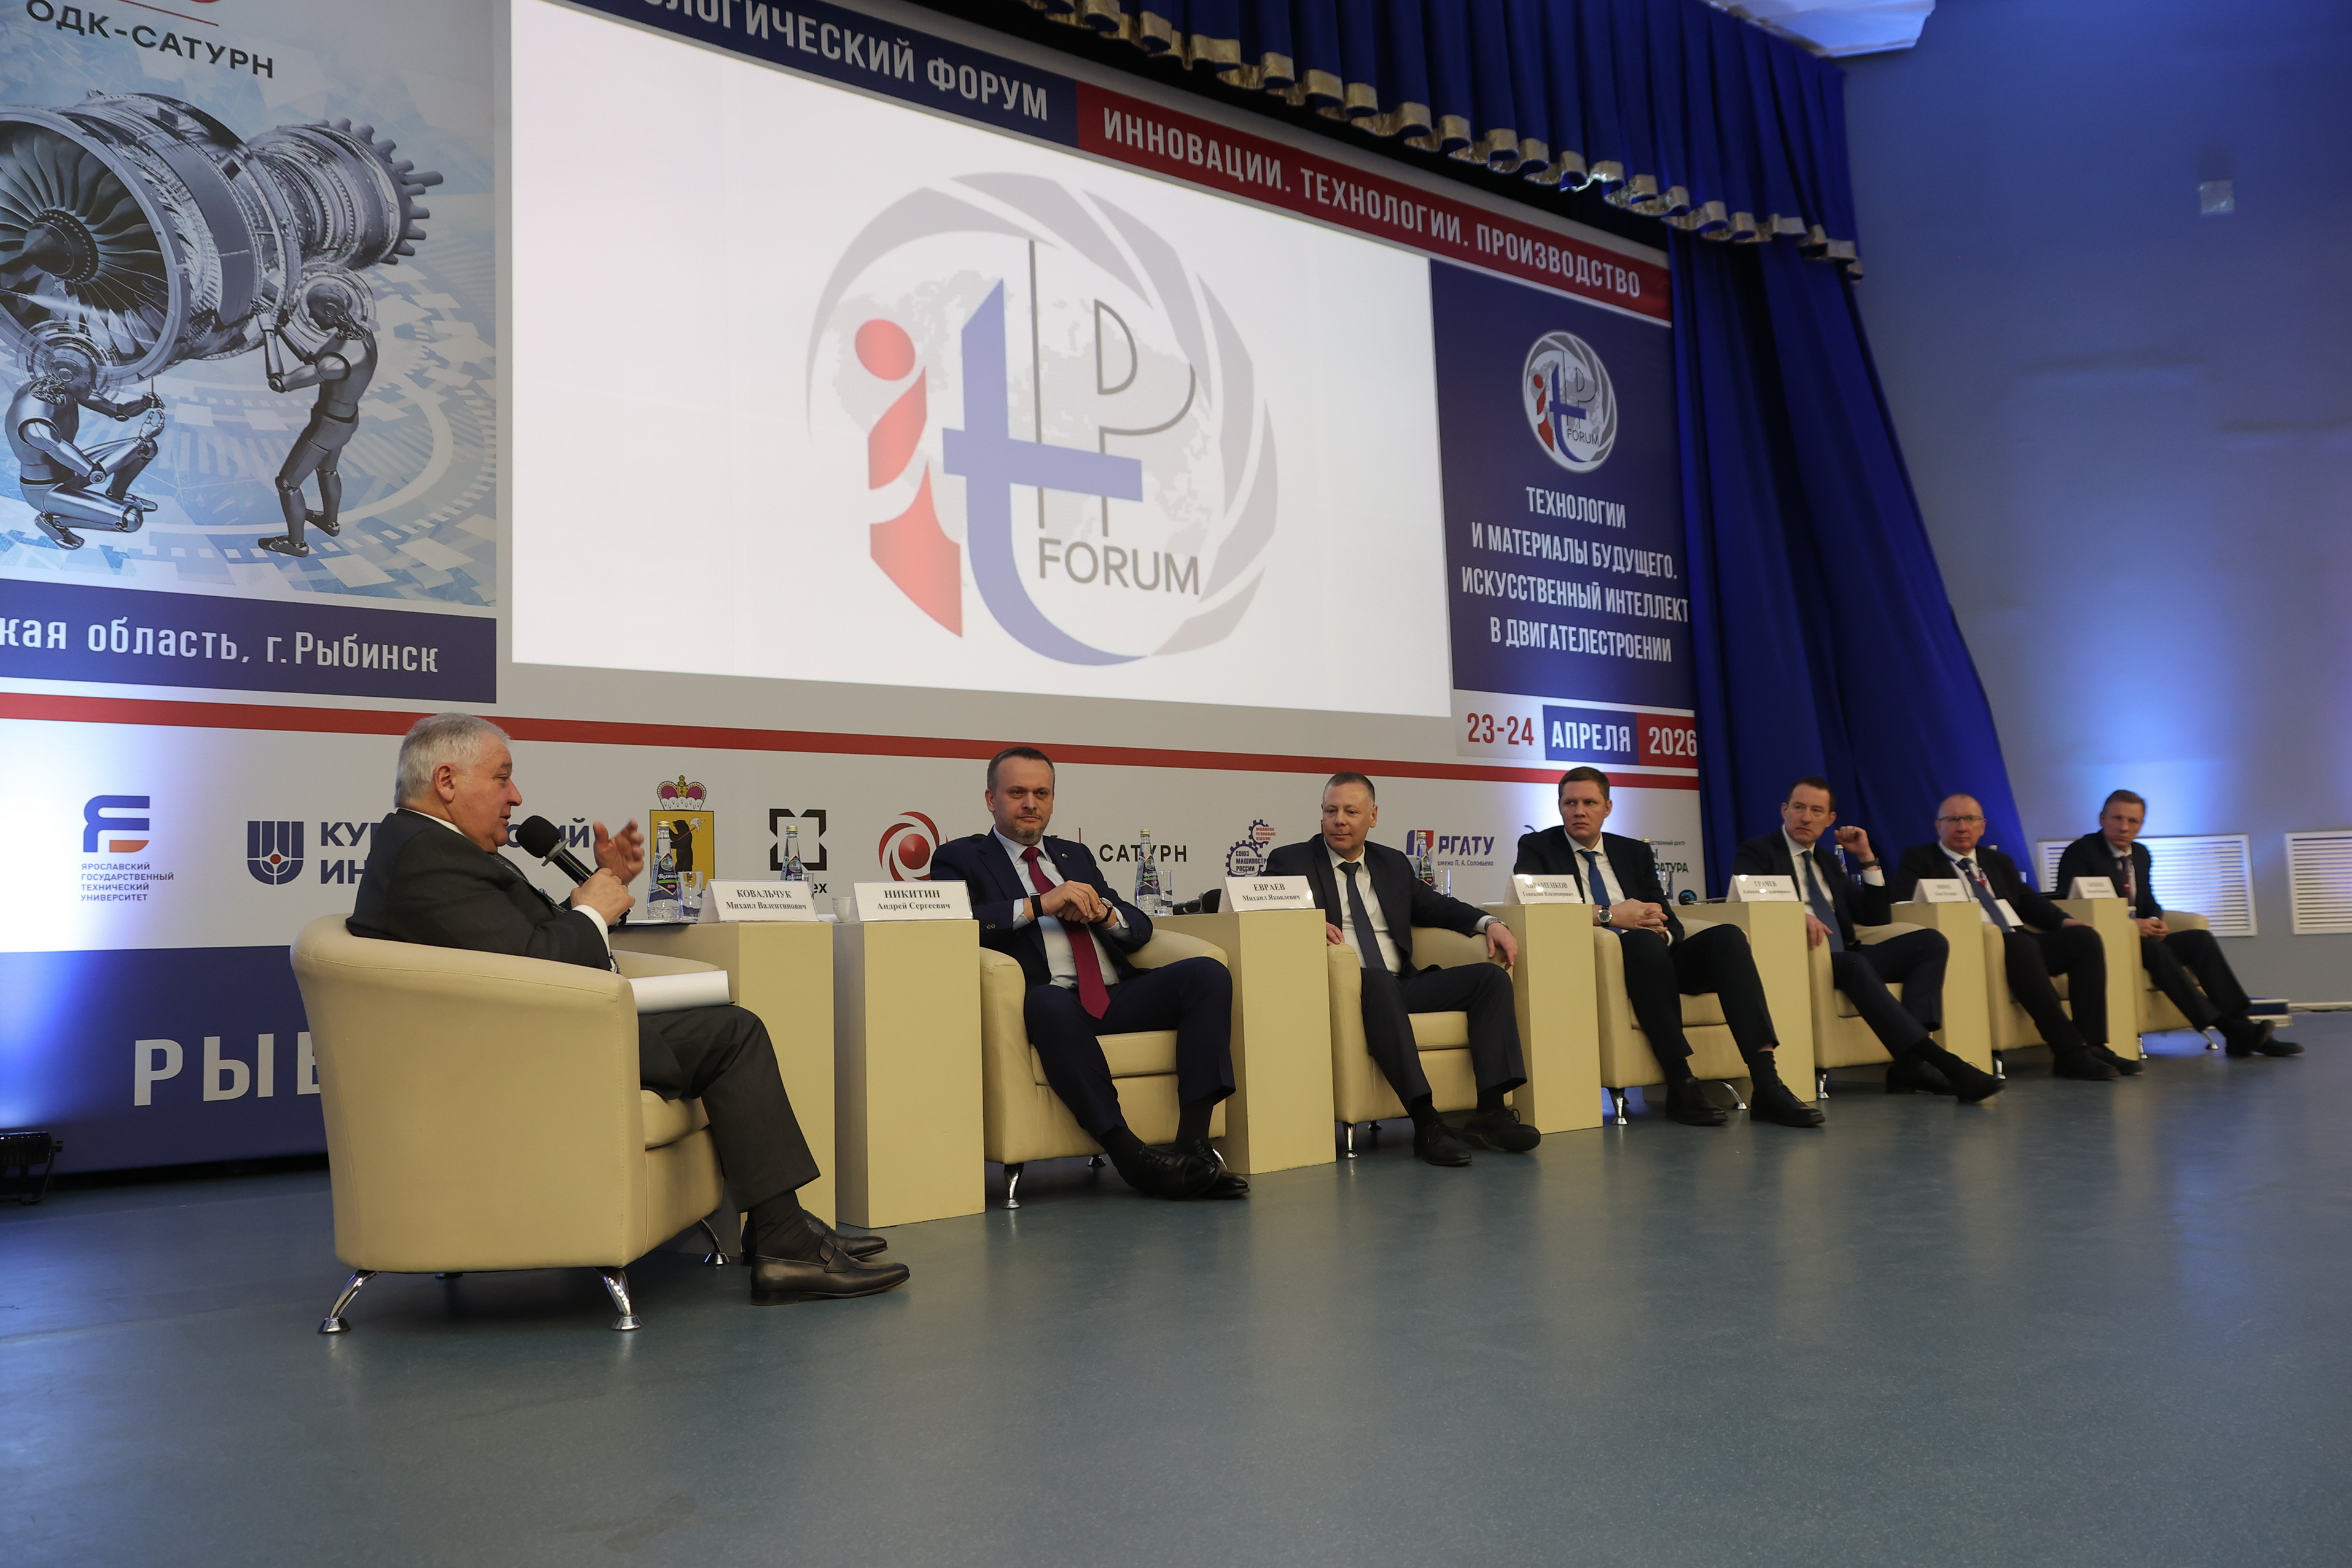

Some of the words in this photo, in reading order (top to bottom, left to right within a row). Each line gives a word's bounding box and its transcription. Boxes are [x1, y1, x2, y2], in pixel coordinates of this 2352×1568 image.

[26, 0, 273, 79] ОДК-САТУРН
[645, 0, 914, 82] ОГИЧЕСКИЙ
[927, 57, 1048, 121] ФОРУМ
[1104, 107, 1291, 193] ИННОВАЦИИ.
[1300, 167, 1469, 247] ТЕХНОЛОГИИ.
[1476, 223, 1641, 298] ПРОИЗВОДСТВО
[1567, 429, 1600, 446] FORUM
[1526, 486, 1627, 529] ТЕХНОЛОГИИ
[1038, 537, 1200, 595] FORUM
[1471, 521, 1484, 549] И
[1488, 524, 1589, 566] МАТЕРИАЛЫ
[1593, 546, 1678, 580] БУДУЩЕГО.
[1462, 566, 1602, 611] ИСКУССТВЕННЫЙ
[1605, 589, 1689, 623] ИНТЕЛЛЕКТ
[88, 616, 249, 664] область,
[1490, 616, 1501, 643] В
[1505, 619, 1672, 663] ДВИГАТЕЛЕСТРОЕНИИ
[1467, 713, 1535, 747] 23-24
[1551, 720, 1631, 753] АПРЕЛЯ
[1649, 726, 1698, 757] 2026
[81, 862, 150, 871] ЯРОСЛАВСКИЙ
[1438, 836, 1495, 856] РГАТУ
[1654, 862, 1689, 873] РАТУРА
[81, 872, 174, 882] ГОСУДАРСТВЕННЫЙ
[81, 882, 149, 891] ТЕХНИЧЕСКИЙ
[736, 890, 792, 898] КОВАЛЬЧУК
[877, 902, 907, 911] Андрей
[909, 902, 951, 911] Сергеевич
